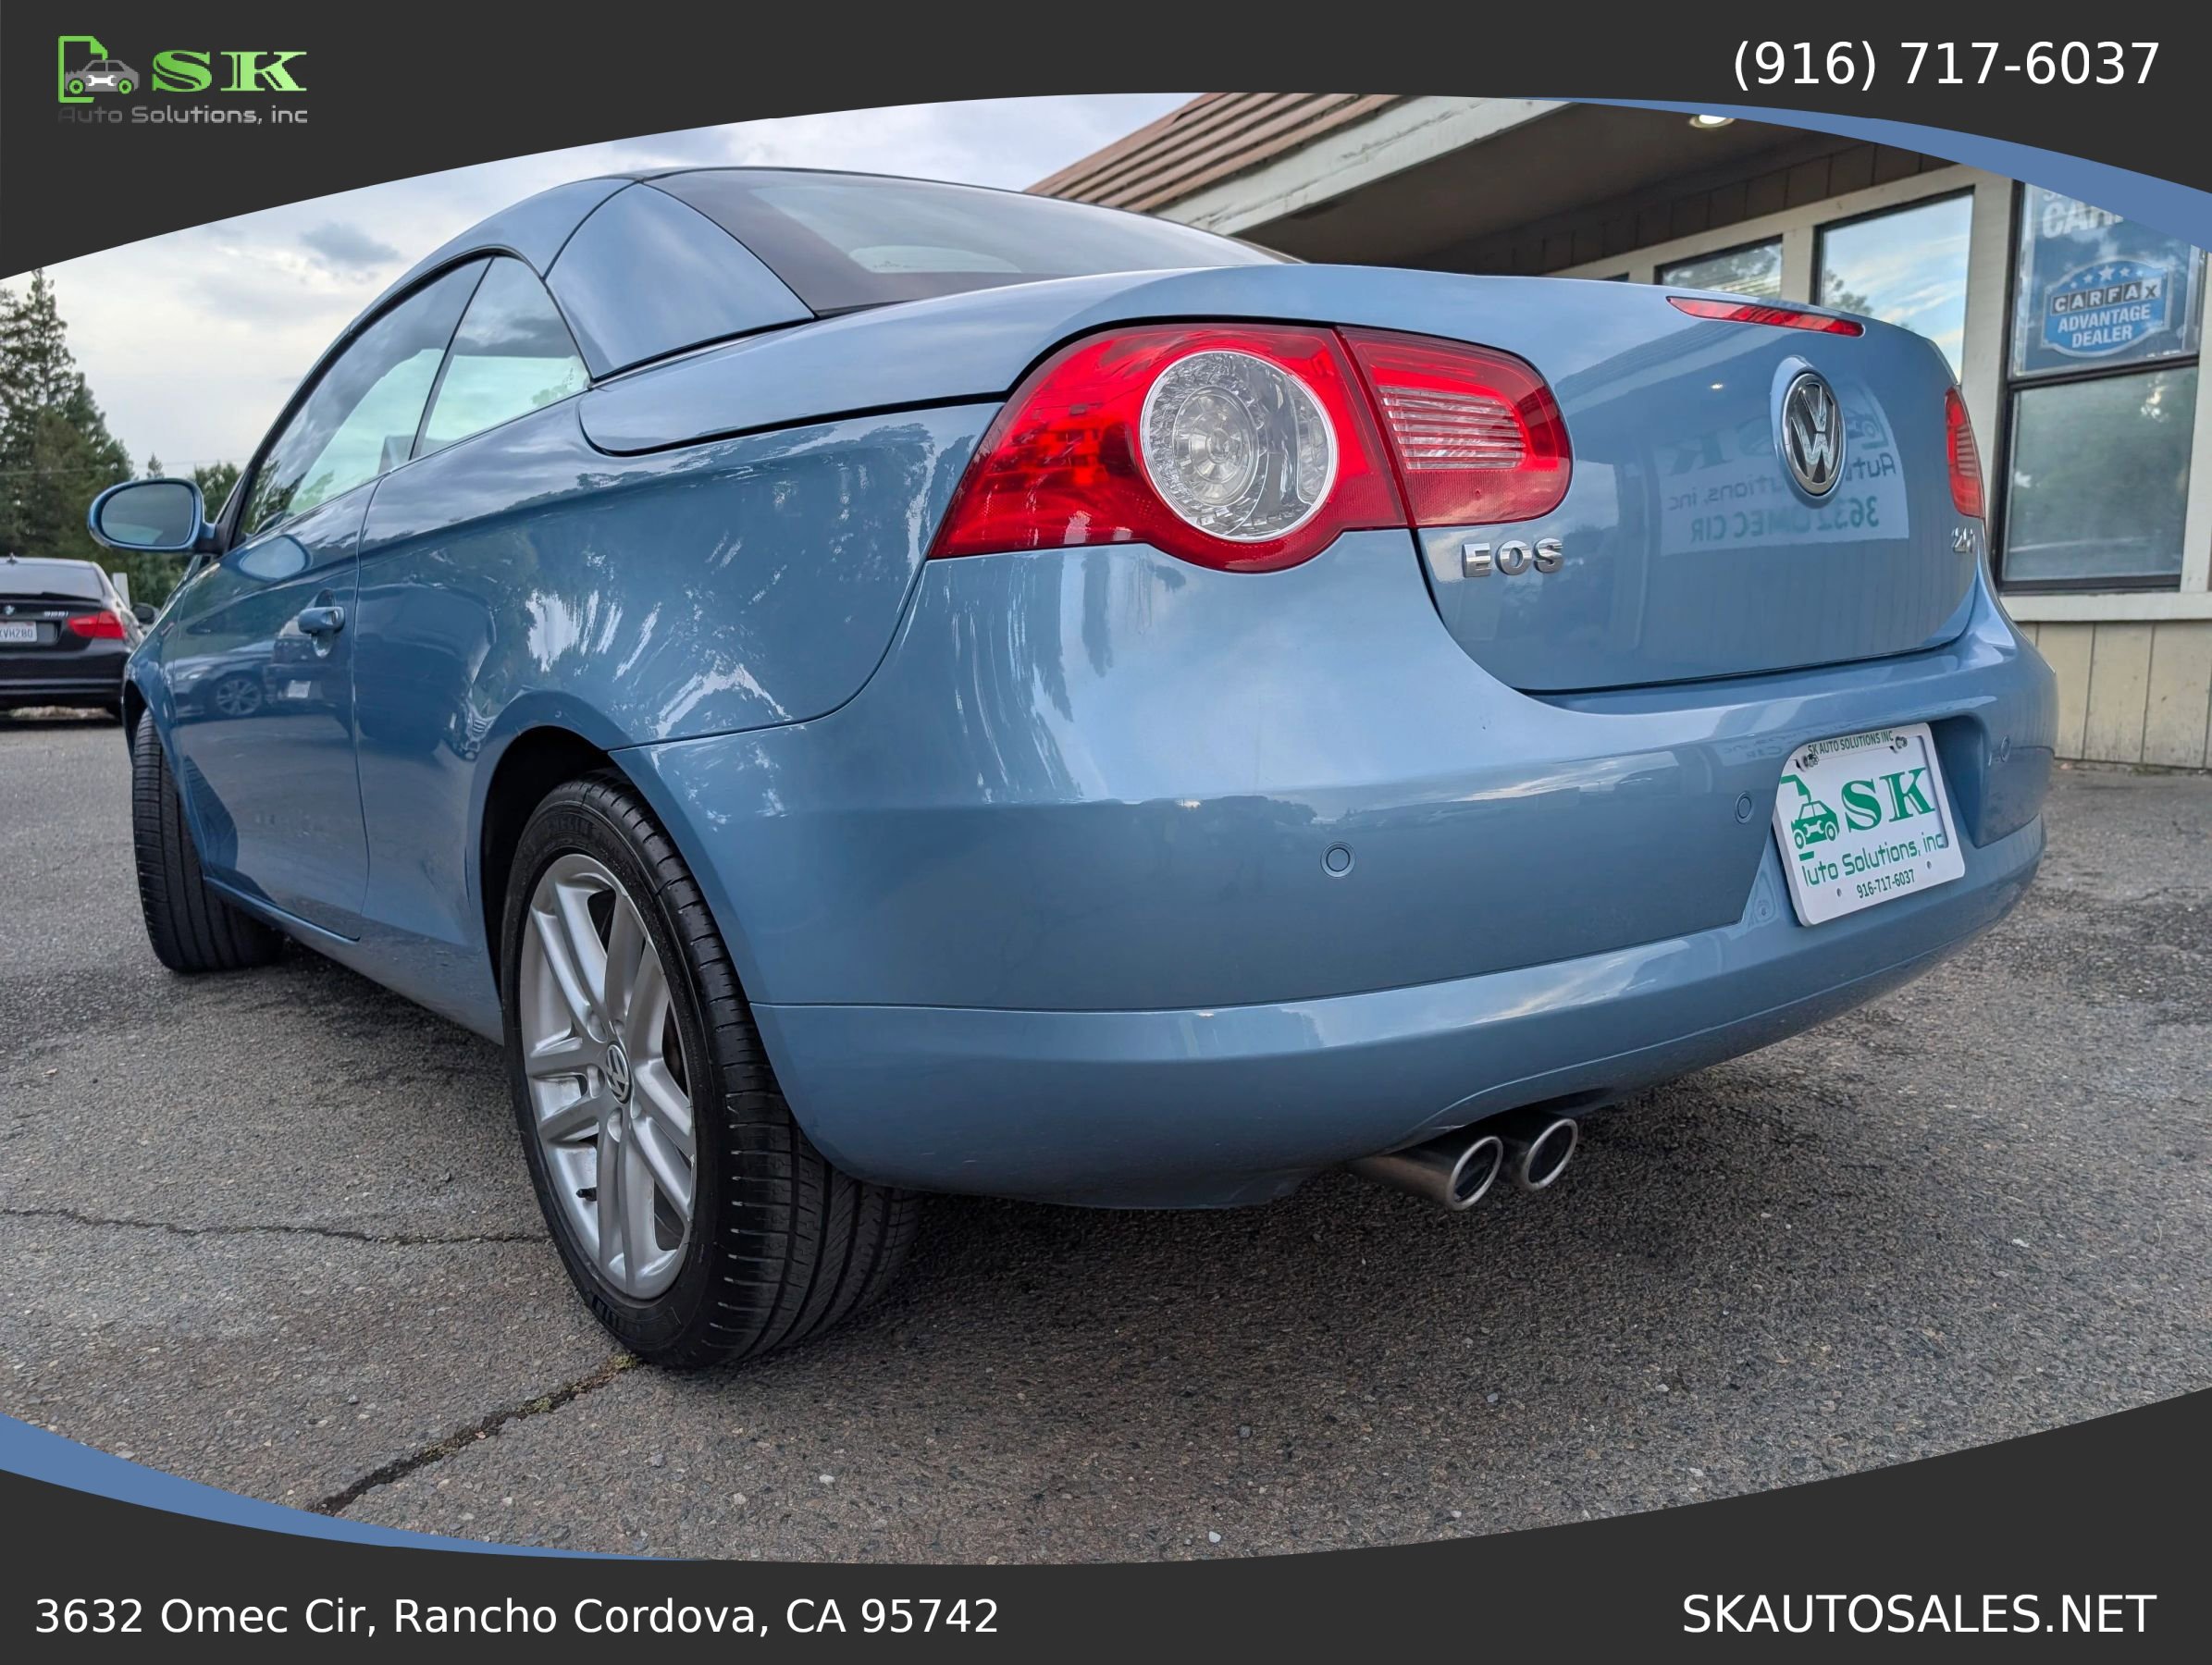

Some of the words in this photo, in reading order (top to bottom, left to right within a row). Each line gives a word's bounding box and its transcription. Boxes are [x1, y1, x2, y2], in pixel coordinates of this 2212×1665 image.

[2052, 281, 2160, 314] CARFAX
[2058, 303, 2152, 333] ADVANTAGE
[2071, 326, 2133, 349] DEALER
[1462, 538, 1563, 578] EOS
[1820, 741, 1839, 754] AUTO
[1840, 733, 1881, 750] SOLUTIONS
[1881, 730, 1894, 744] INC
[1841, 767, 1935, 832] SK
[1842, 841, 1922, 877] Solutions,
[1922, 832, 1945, 854] inc
[1856, 869, 1916, 899] 916-717-6037
